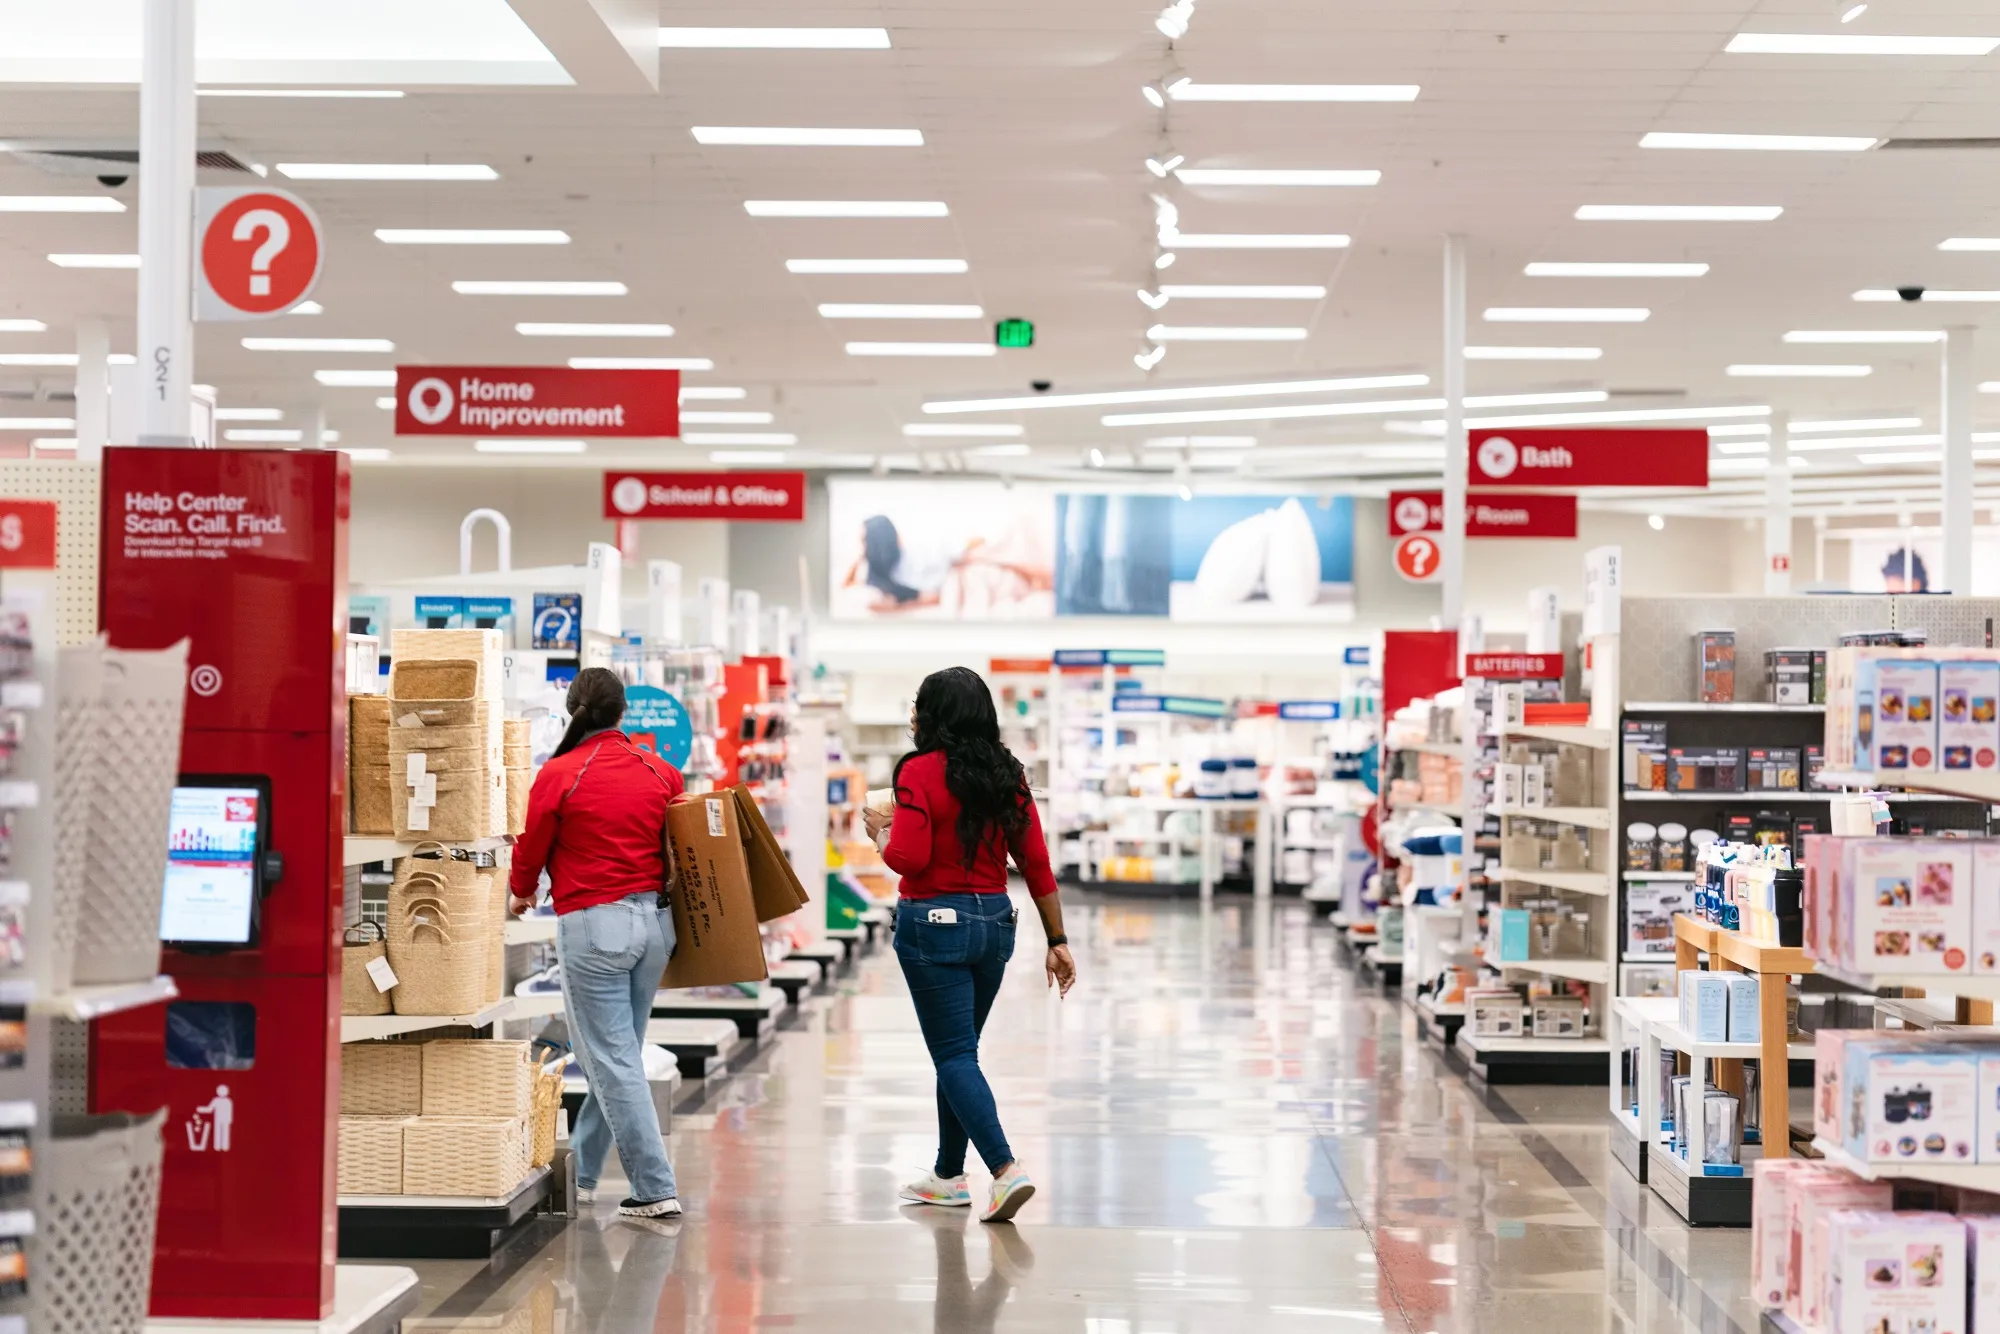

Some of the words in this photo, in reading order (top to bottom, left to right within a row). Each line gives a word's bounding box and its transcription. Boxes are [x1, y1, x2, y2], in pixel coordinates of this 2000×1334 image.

[460, 377, 534, 401] Home
[460, 404, 624, 429] Improvement
[1521, 446, 1572, 468] Bath
[125, 491, 173, 515] Help
[177, 491, 247, 512] Center
[650, 485, 713, 506] School
[715, 485, 730, 507] &
[732, 485, 789, 507] Office
[125, 514, 182, 533] Scan.
[187, 514, 231, 533] Call.
[236, 514, 286, 533] Find.
[1476, 505, 1529, 525] Room
[124, 536, 175, 547] Download
[178, 536, 195, 547] the
[198, 536, 229, 549] Target
[124, 548, 139, 558] for
[141, 548, 193, 558] interactive
[1473, 657, 1546, 672] BATTERIES
[686, 846, 702, 888] #2155
[699, 901, 708, 910] 6
[688, 914, 701, 948] BOXES
